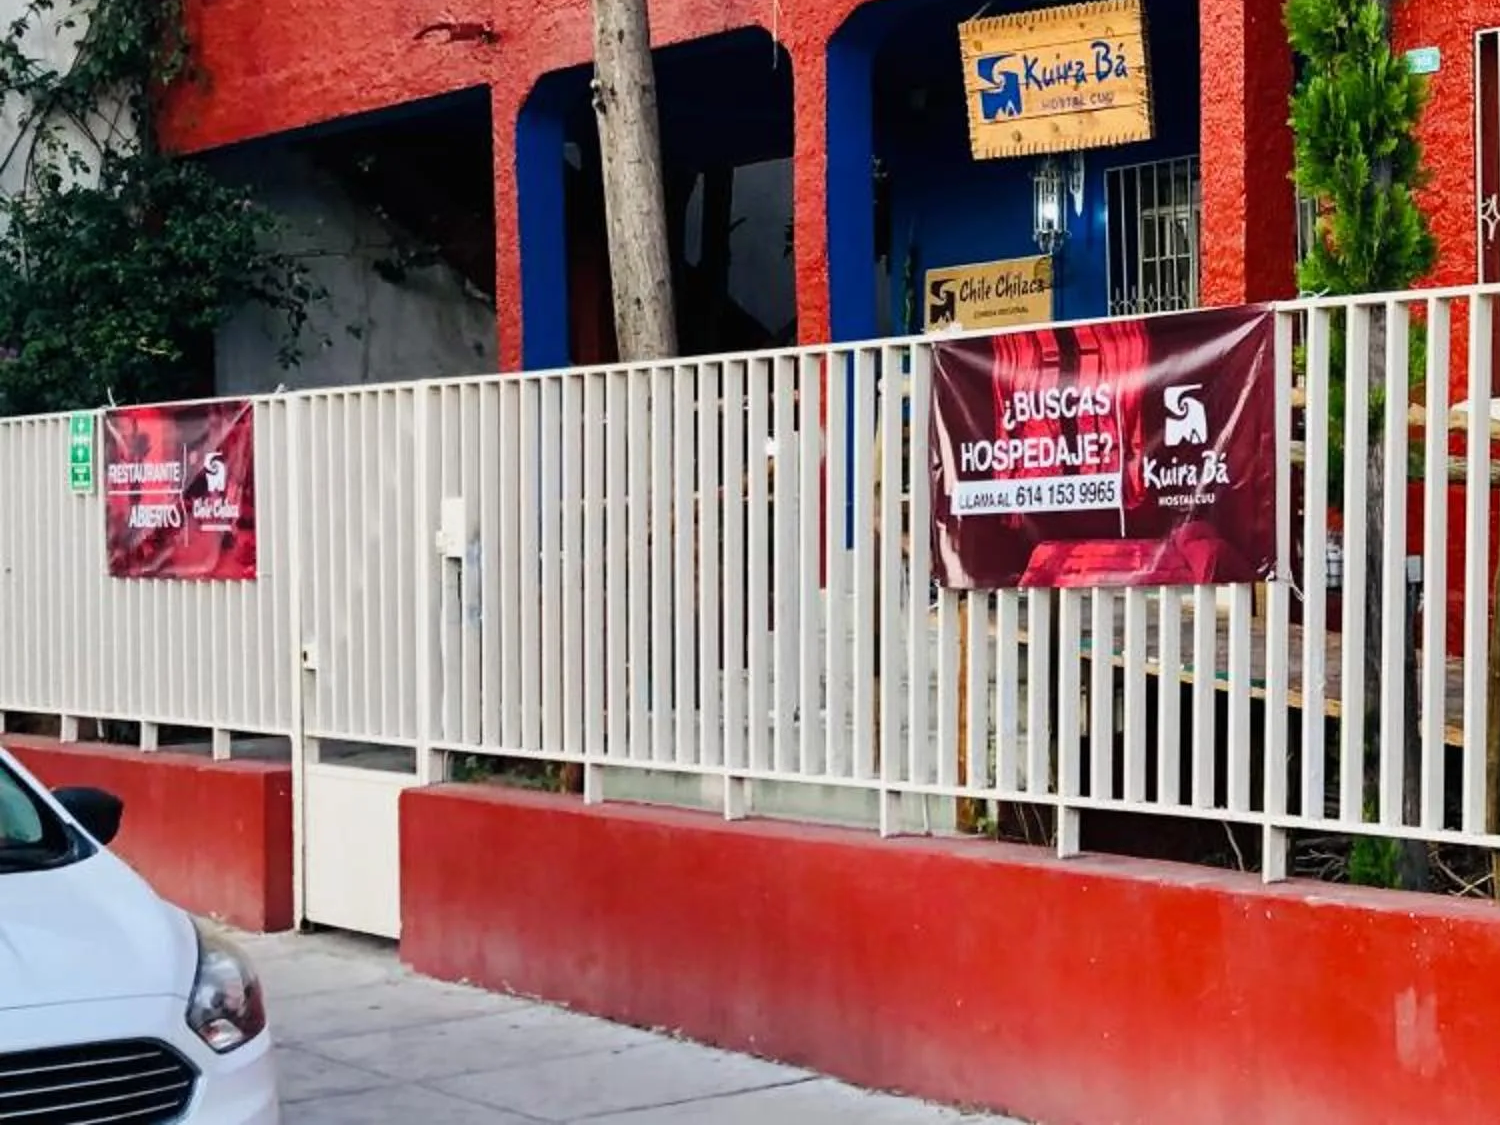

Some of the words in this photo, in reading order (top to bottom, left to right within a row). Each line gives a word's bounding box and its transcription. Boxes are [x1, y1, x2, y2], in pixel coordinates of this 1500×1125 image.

[1022, 52, 1088, 91] Kuira
[1090, 38, 1129, 83] Bá
[960, 277, 991, 304] Chile
[995, 272, 1046, 299] Chilaca
[1002, 383, 1112, 431] ¿BUSCAS
[960, 432, 1113, 473] HOSPEDAJE?
[1143, 456, 1197, 490] Kuira
[1201, 450, 1231, 485] Bá
[107, 461, 181, 485] RESTAURANTE
[959, 493, 995, 510] LLAMA
[995, 491, 1011, 508] AL
[1015, 484, 1043, 507] 614
[1048, 482, 1076, 506] 153
[1079, 480, 1115, 504] 9965
[128, 503, 182, 529] ABIERTO
